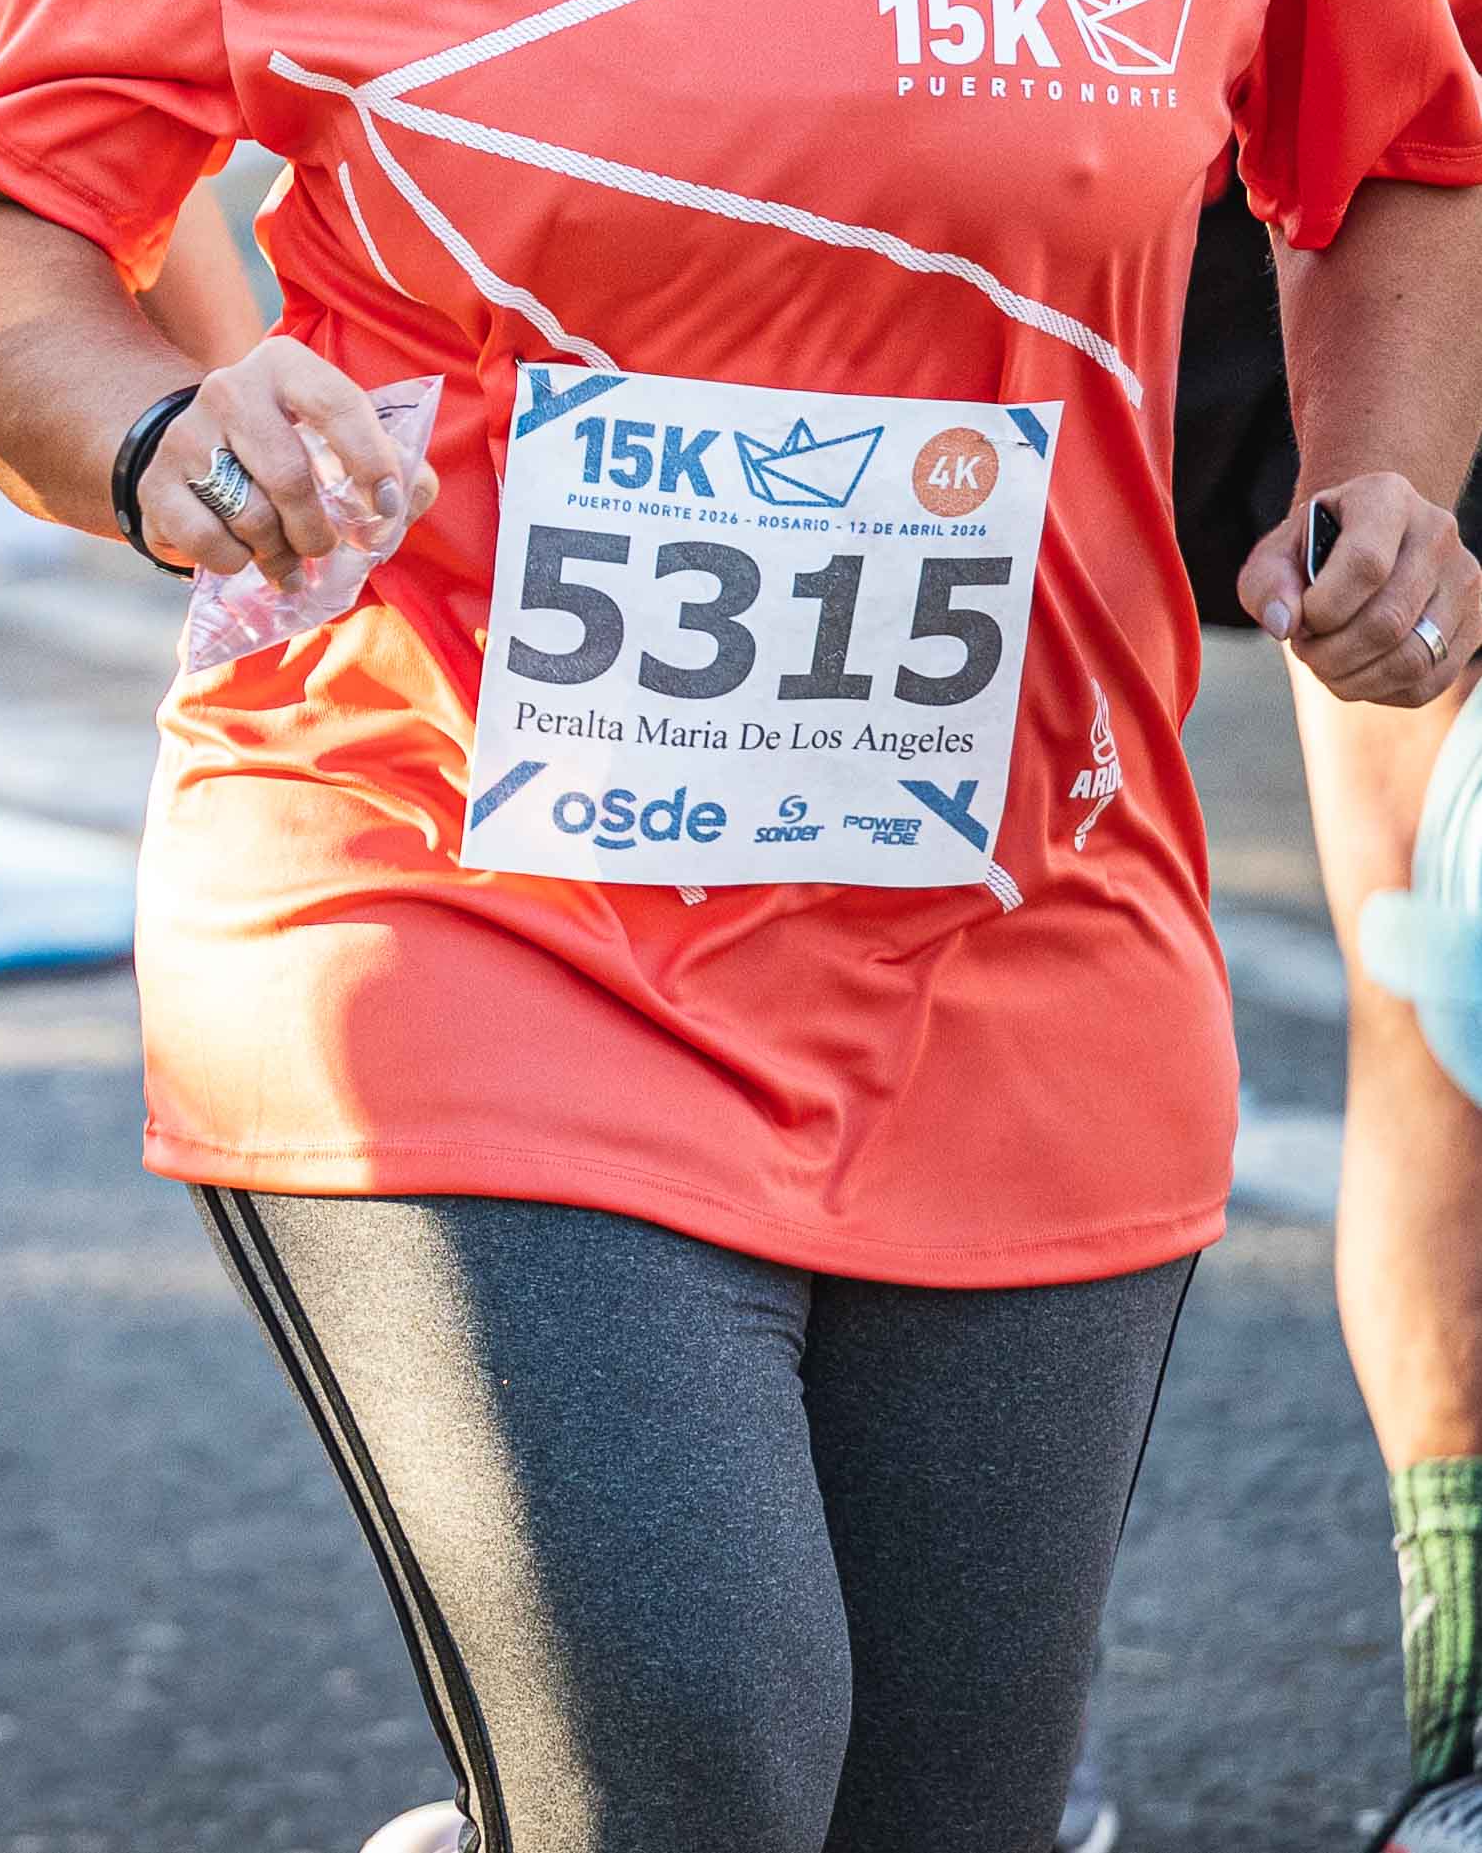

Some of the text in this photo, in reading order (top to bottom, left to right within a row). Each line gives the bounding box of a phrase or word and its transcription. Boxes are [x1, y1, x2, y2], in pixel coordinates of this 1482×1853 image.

[573, 414, 722, 499] 15K
[927, 454, 984, 491] 4K
[567, 493, 632, 513] PUERTO
[638, 502, 692, 521] NORTE
[698, 509, 739, 525] 2026
[758, 515, 830, 532] ROSARIO
[850, 520, 868, 535] 12
[872, 522, 894, 536] DE
[899, 522, 944, 536] ABRIL
[950, 523, 987, 537] 2026
[506, 523, 1013, 707] 5315
[514, 700, 975, 761] Peralta Maria De Los Angeles
[552, 785, 727, 843] osde
[843, 815, 922, 832] POWER
